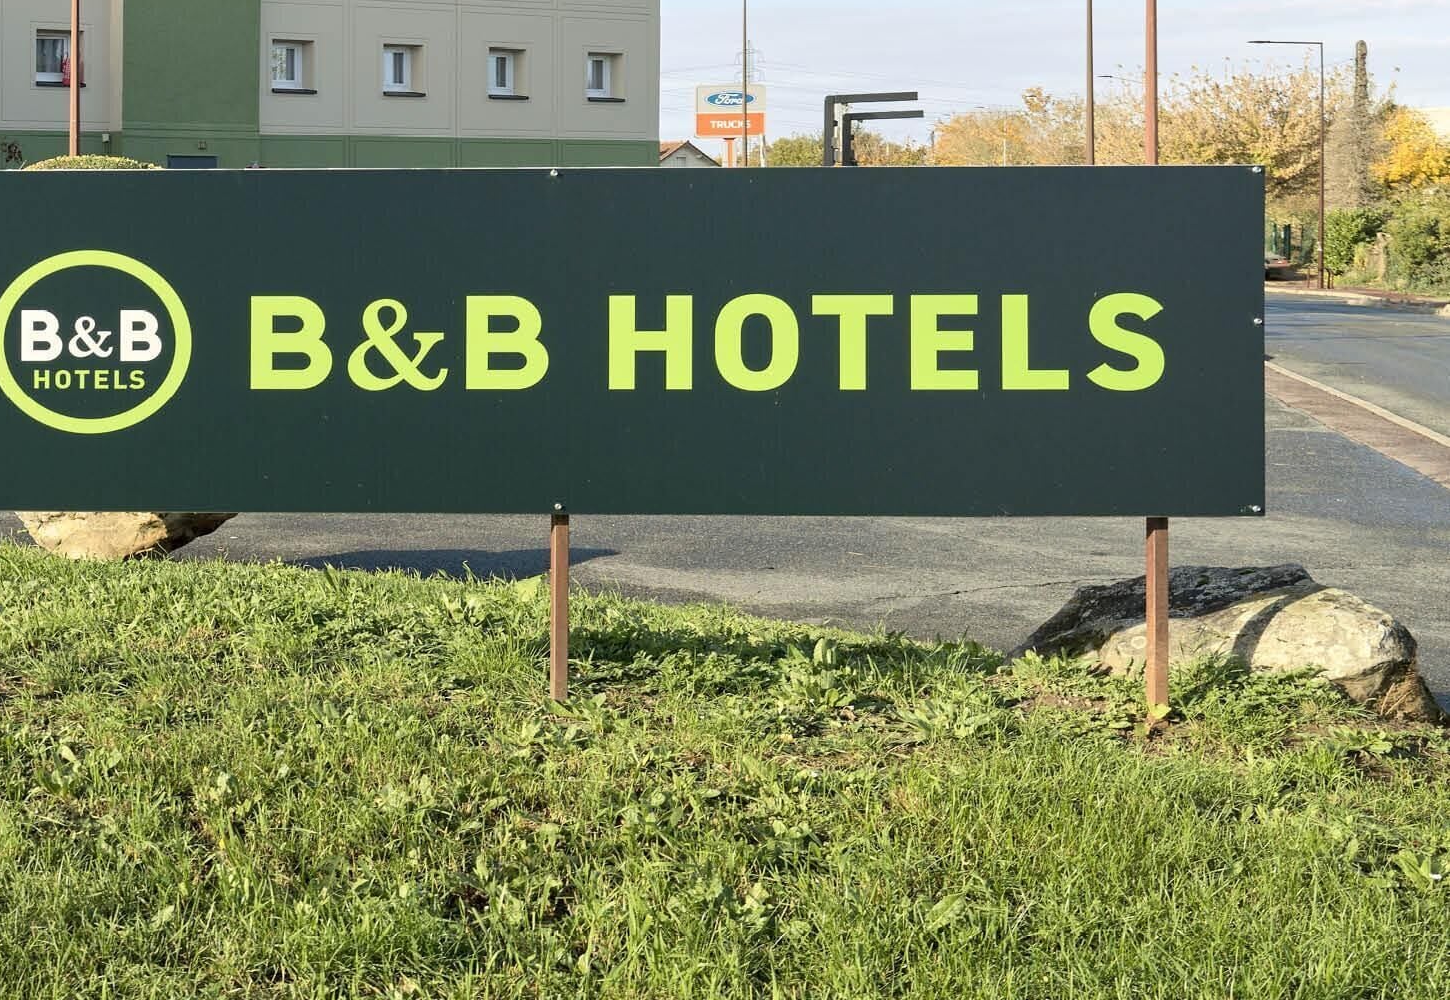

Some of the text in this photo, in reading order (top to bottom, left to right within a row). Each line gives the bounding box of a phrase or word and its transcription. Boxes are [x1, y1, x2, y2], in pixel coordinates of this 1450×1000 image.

[21, 309, 163, 362] B&B
[250, 292, 1166, 392] B&B HOTELS
[33, 369, 146, 390] HOTELS
